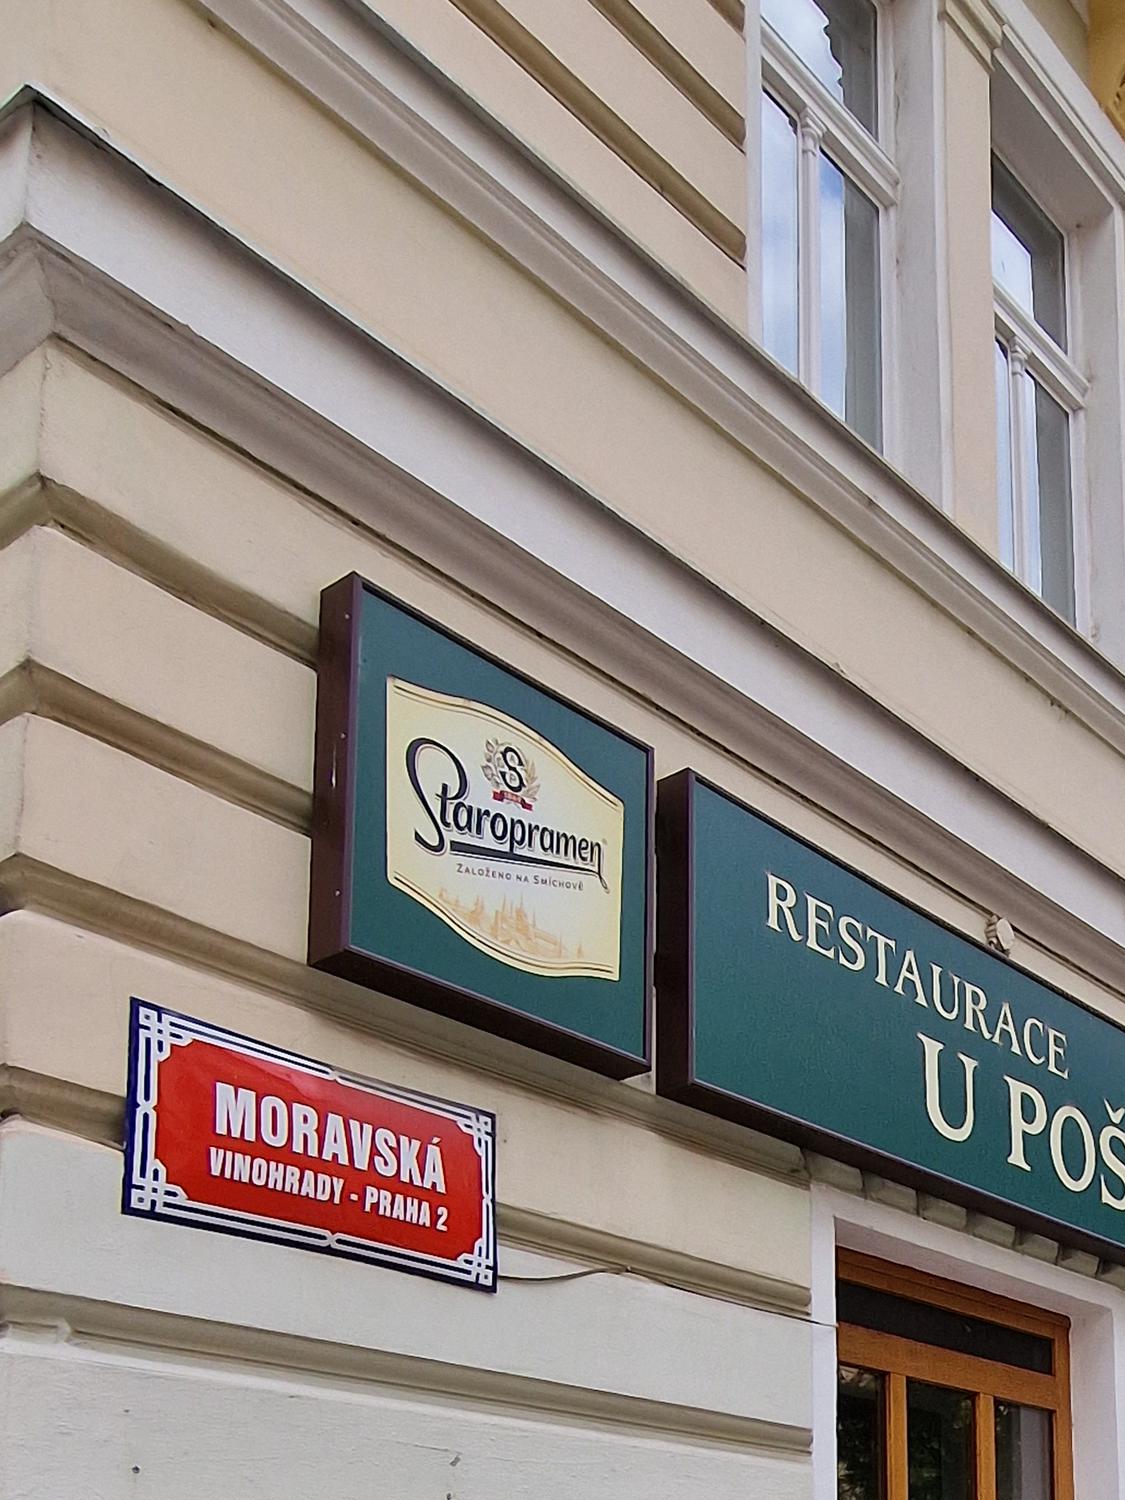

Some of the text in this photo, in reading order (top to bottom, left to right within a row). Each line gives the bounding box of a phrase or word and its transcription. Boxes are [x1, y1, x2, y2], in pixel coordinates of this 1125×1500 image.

[406, 737, 609, 893] Staropramen
[765, 871, 1070, 1079] RESTAURACE
[215, 1081, 447, 1194] MORAVSKÁ
[917, 1032, 978, 1142] U
[209, 1146, 344, 1205] VINOHRADY
[364, 1186, 431, 1228] PRAHA
[436, 1207, 449, 1232] 2
